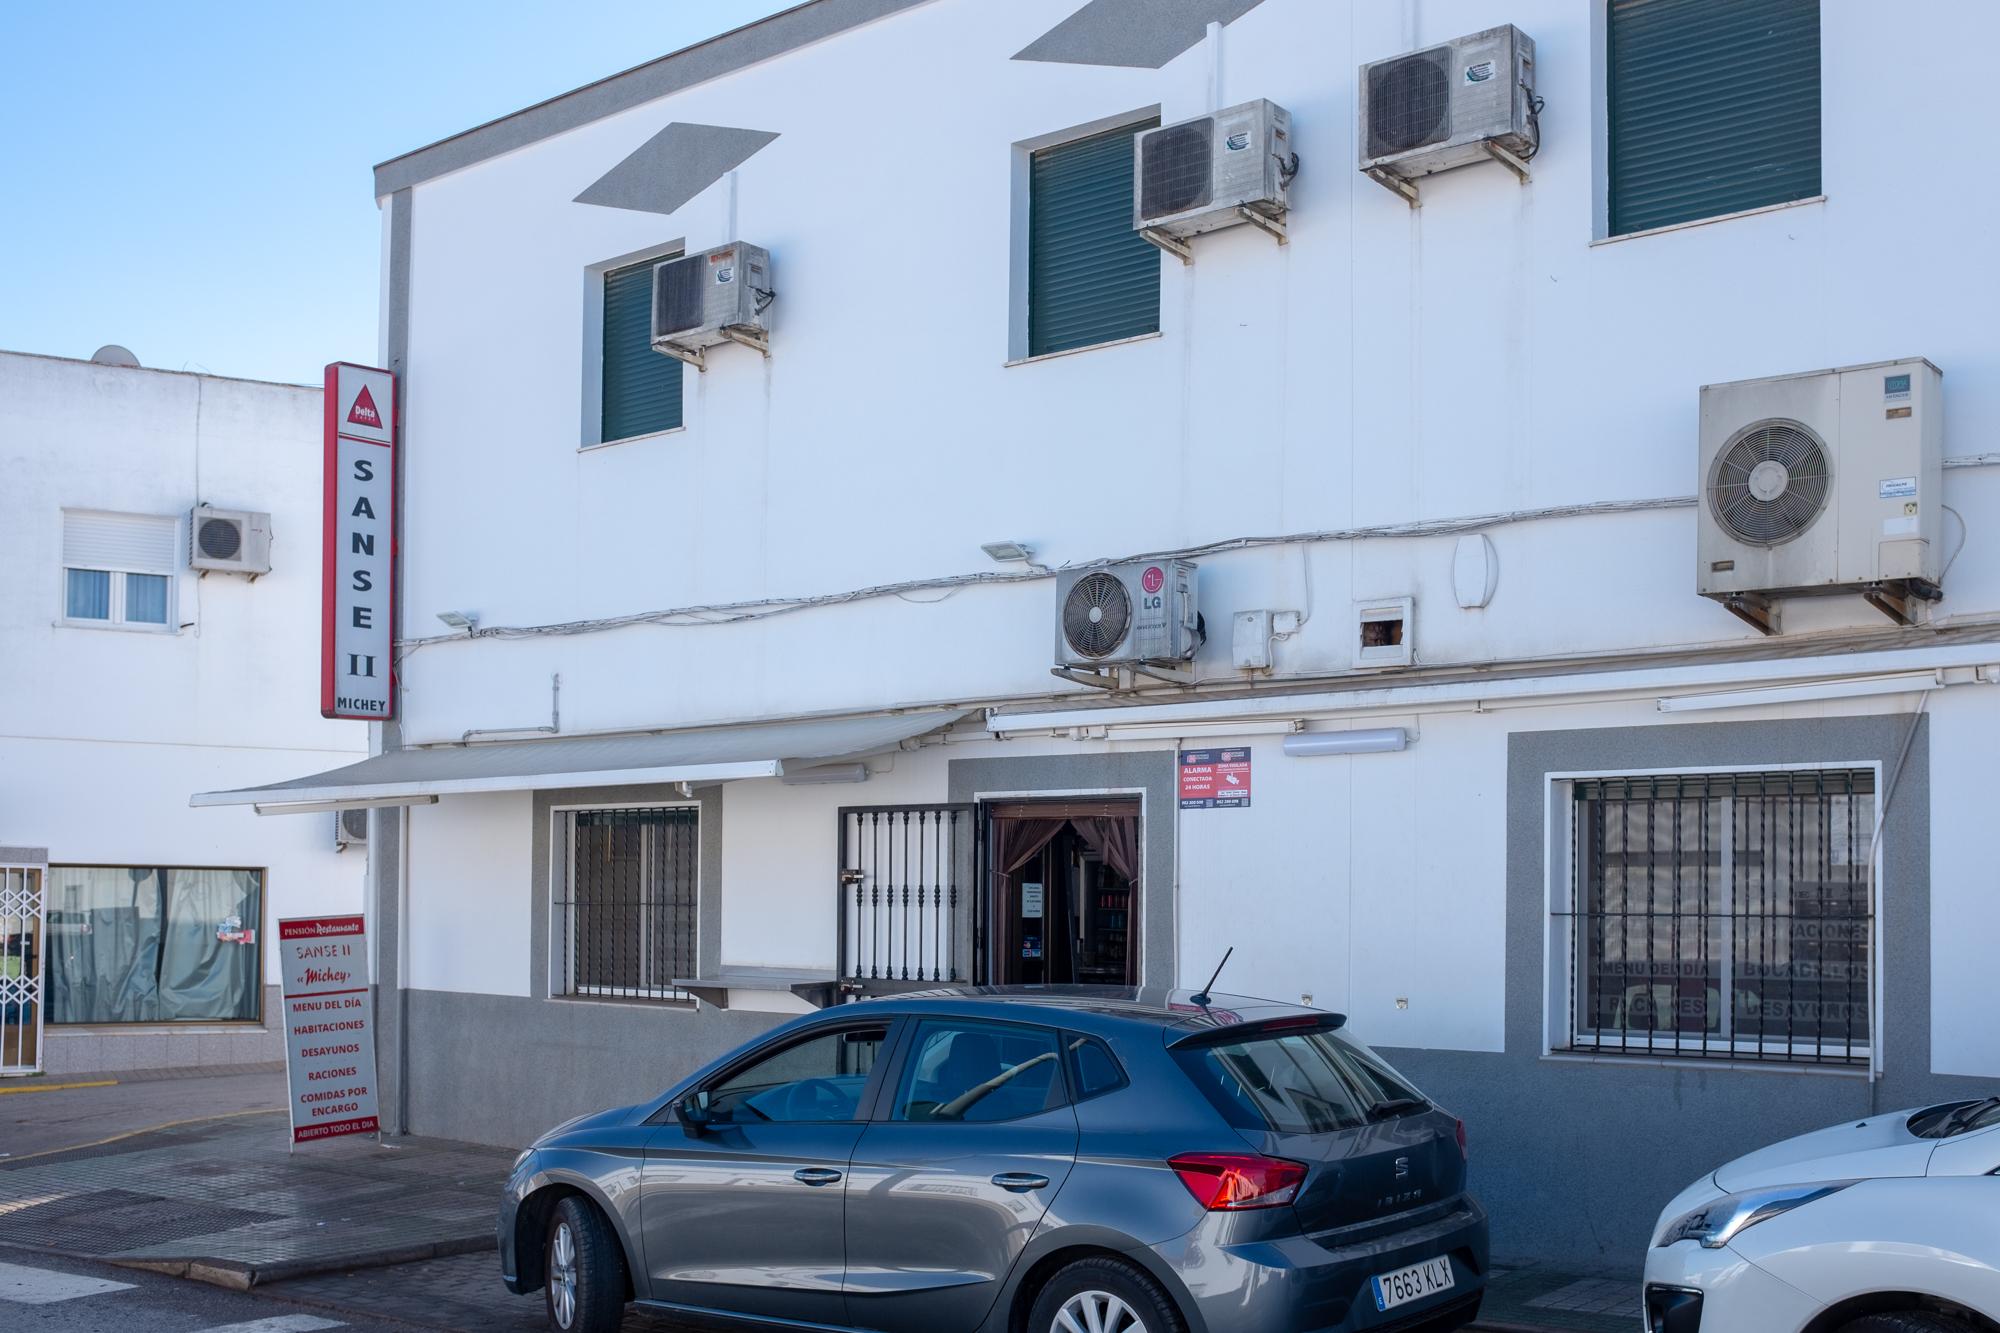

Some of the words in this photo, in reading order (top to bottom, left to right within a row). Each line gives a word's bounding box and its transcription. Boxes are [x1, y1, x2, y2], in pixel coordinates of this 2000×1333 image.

[355, 405, 375, 418] Delta
[351, 459, 376, 630] SANSE
[1143, 596, 1162, 610] LG
[337, 696, 386, 712] MICHEY
[1183, 766, 1212, 774] ALARMA
[315, 922, 360, 935] Restaurante
[296, 944, 338, 960] SANSE
[292, 1001, 323, 1013] MENU
[324, 999, 343, 1010] DEL
[344, 996, 362, 1009] DÍA
[293, 1019, 365, 1036] HABITACIONES
[301, 1043, 360, 1058] DESAYUNOS
[308, 1066, 357, 1081] RACIONES
[300, 1089, 346, 1104] COMIDAS
[348, 1086, 368, 1098] POR
[312, 1102, 359, 1117] ENCARGO
[297, 1126, 330, 1139] ABIERTO
[330, 1123, 351, 1135] TODO
[352, 1121, 361, 1131] EL
[1382, 1269, 1422, 1304] 7663
[1423, 1258, 1452, 1292] KLX
